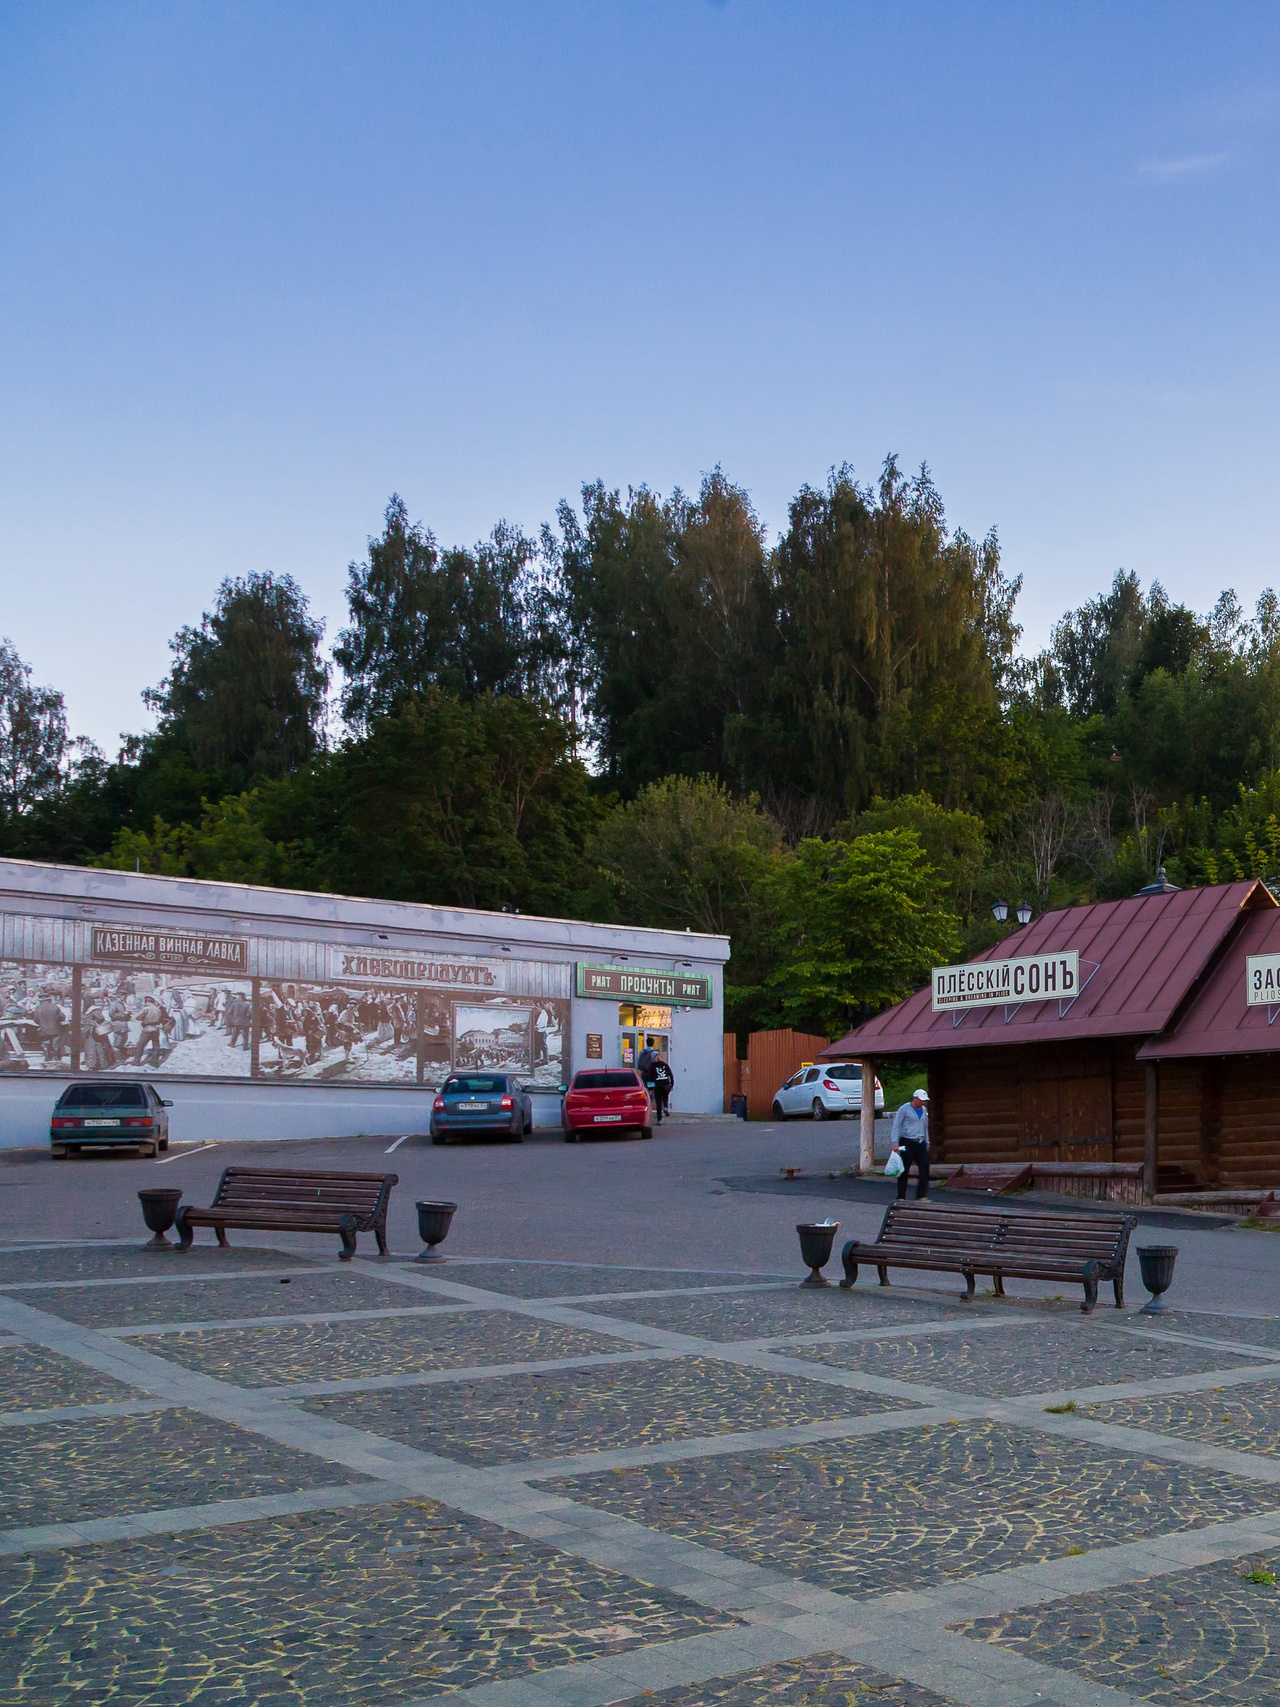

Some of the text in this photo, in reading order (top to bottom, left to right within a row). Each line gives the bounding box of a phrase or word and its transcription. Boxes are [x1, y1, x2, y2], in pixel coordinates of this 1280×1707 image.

[96, 932, 241, 963] КАЗЕННАЯ ВИННАЯ ЛАВКА
[342, 955, 495, 986] ХЛЕБОПРОДУКТЪ
[591, 975, 701, 996] РИАТ ПРОДУКТЫ РИАТ
[937, 960, 1074, 995] ПЛЁССКІЙ СОНЪ
